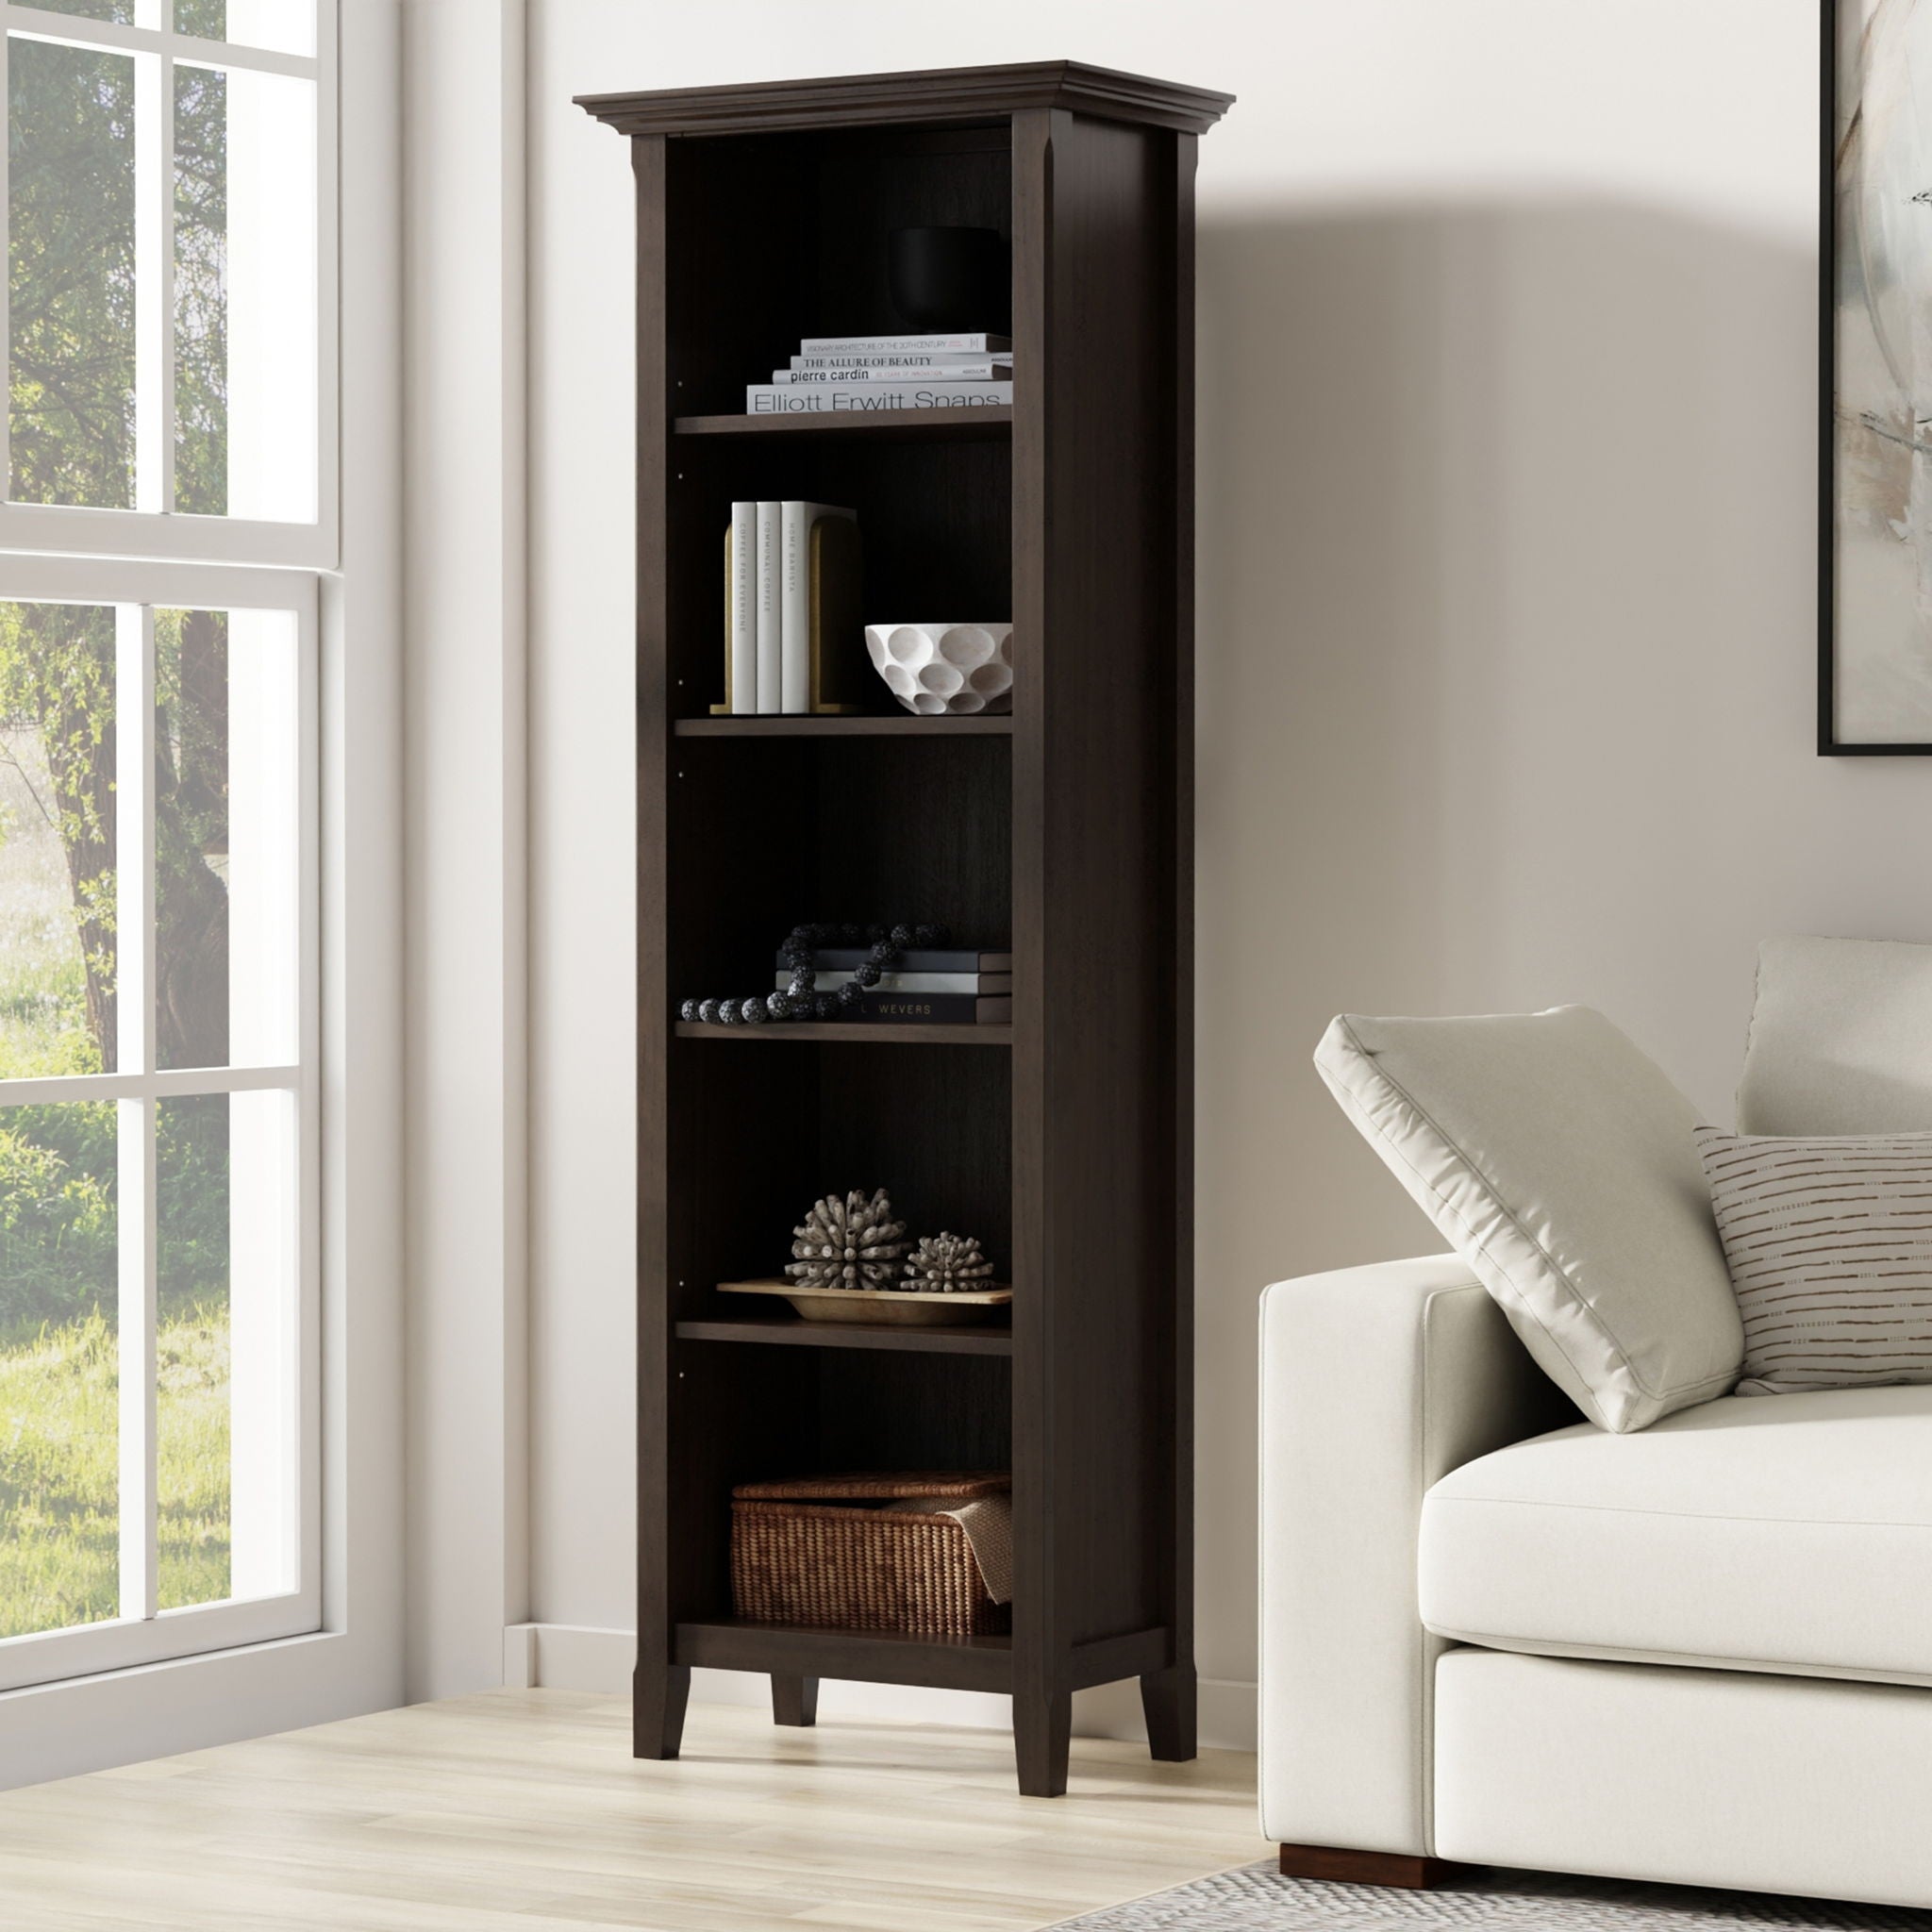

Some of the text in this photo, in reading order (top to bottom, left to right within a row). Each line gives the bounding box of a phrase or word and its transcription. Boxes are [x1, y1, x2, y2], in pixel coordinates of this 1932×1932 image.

[917, 341, 946, 349] CENTURY
[804, 357, 932, 368] THE ALLURE OF BEAUTY
[791, 369, 869, 384] pierre cardin
[755, 393, 822, 412] Elliott
[832, 392, 905, 411] Erwitt
[878, 1004, 931, 1014] WEVERS
